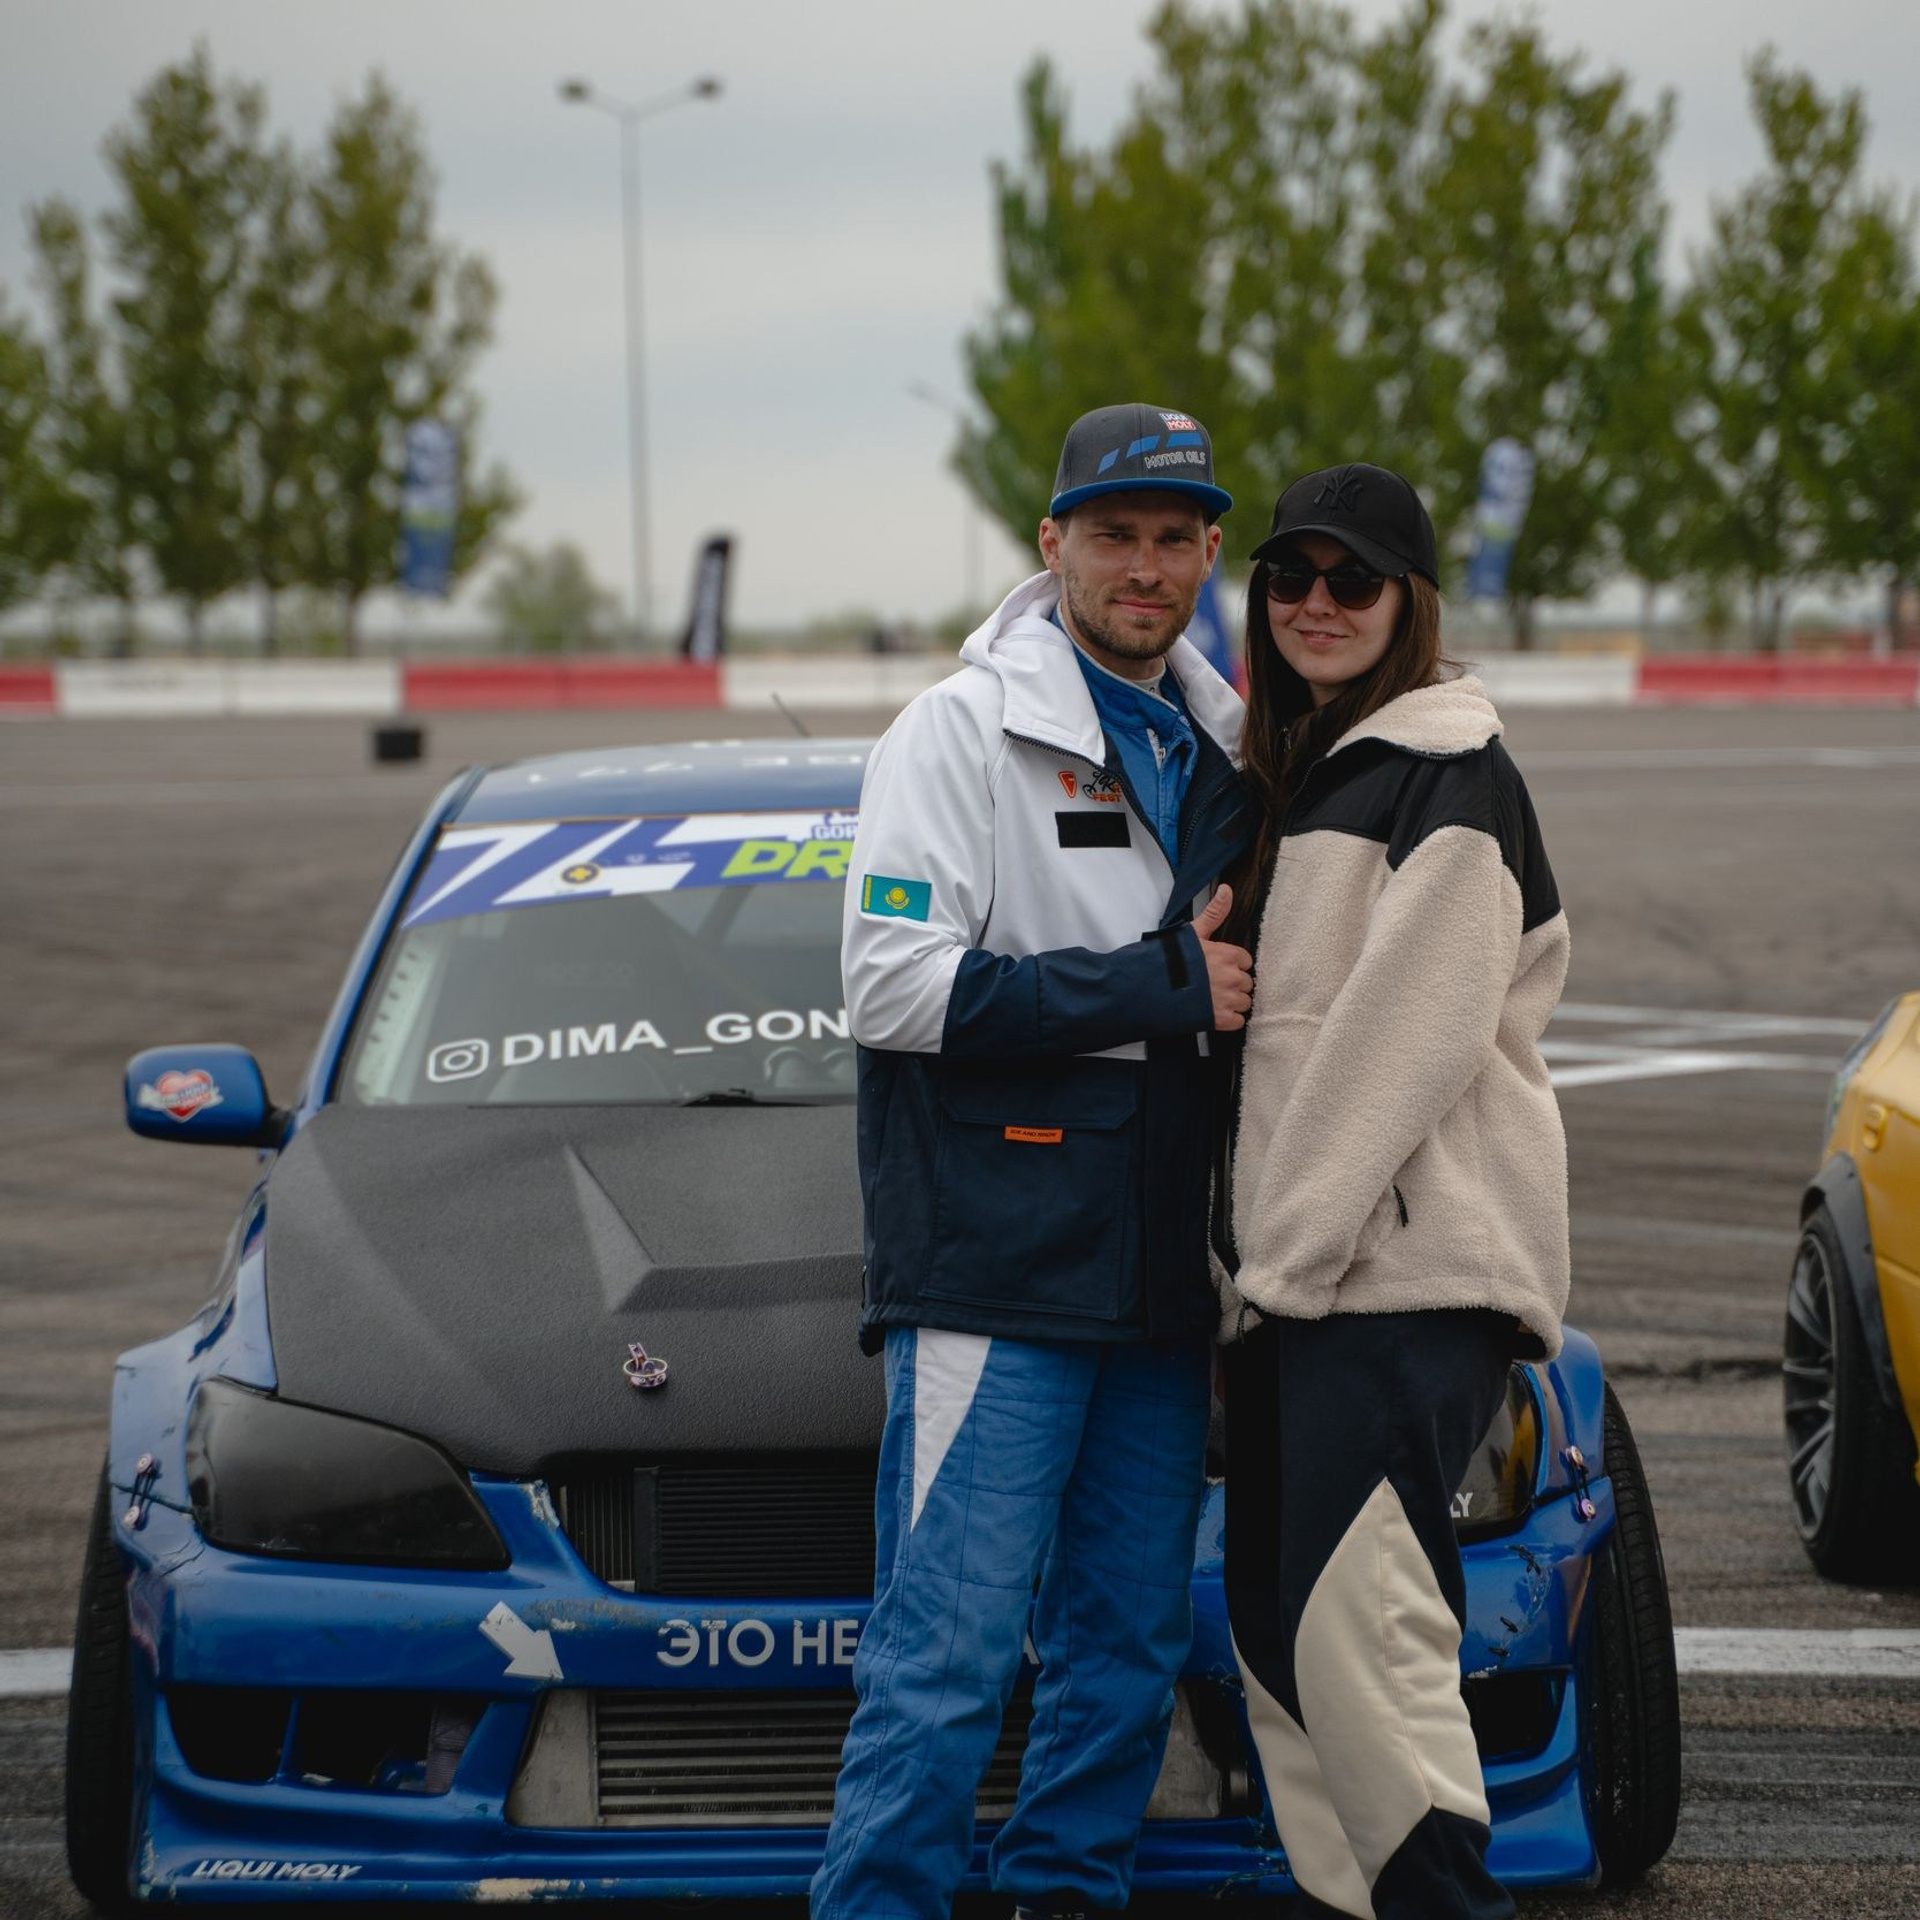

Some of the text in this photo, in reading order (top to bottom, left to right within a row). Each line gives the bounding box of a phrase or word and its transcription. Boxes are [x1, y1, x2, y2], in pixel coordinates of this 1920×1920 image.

[1167, 420, 1196, 430] MOLY
[1144, 450, 1206, 469] MOTOR OILS
[657, 1619, 859, 1666] ЭТО НЕ
[191, 1859, 363, 1882] LIQUI MOLY
